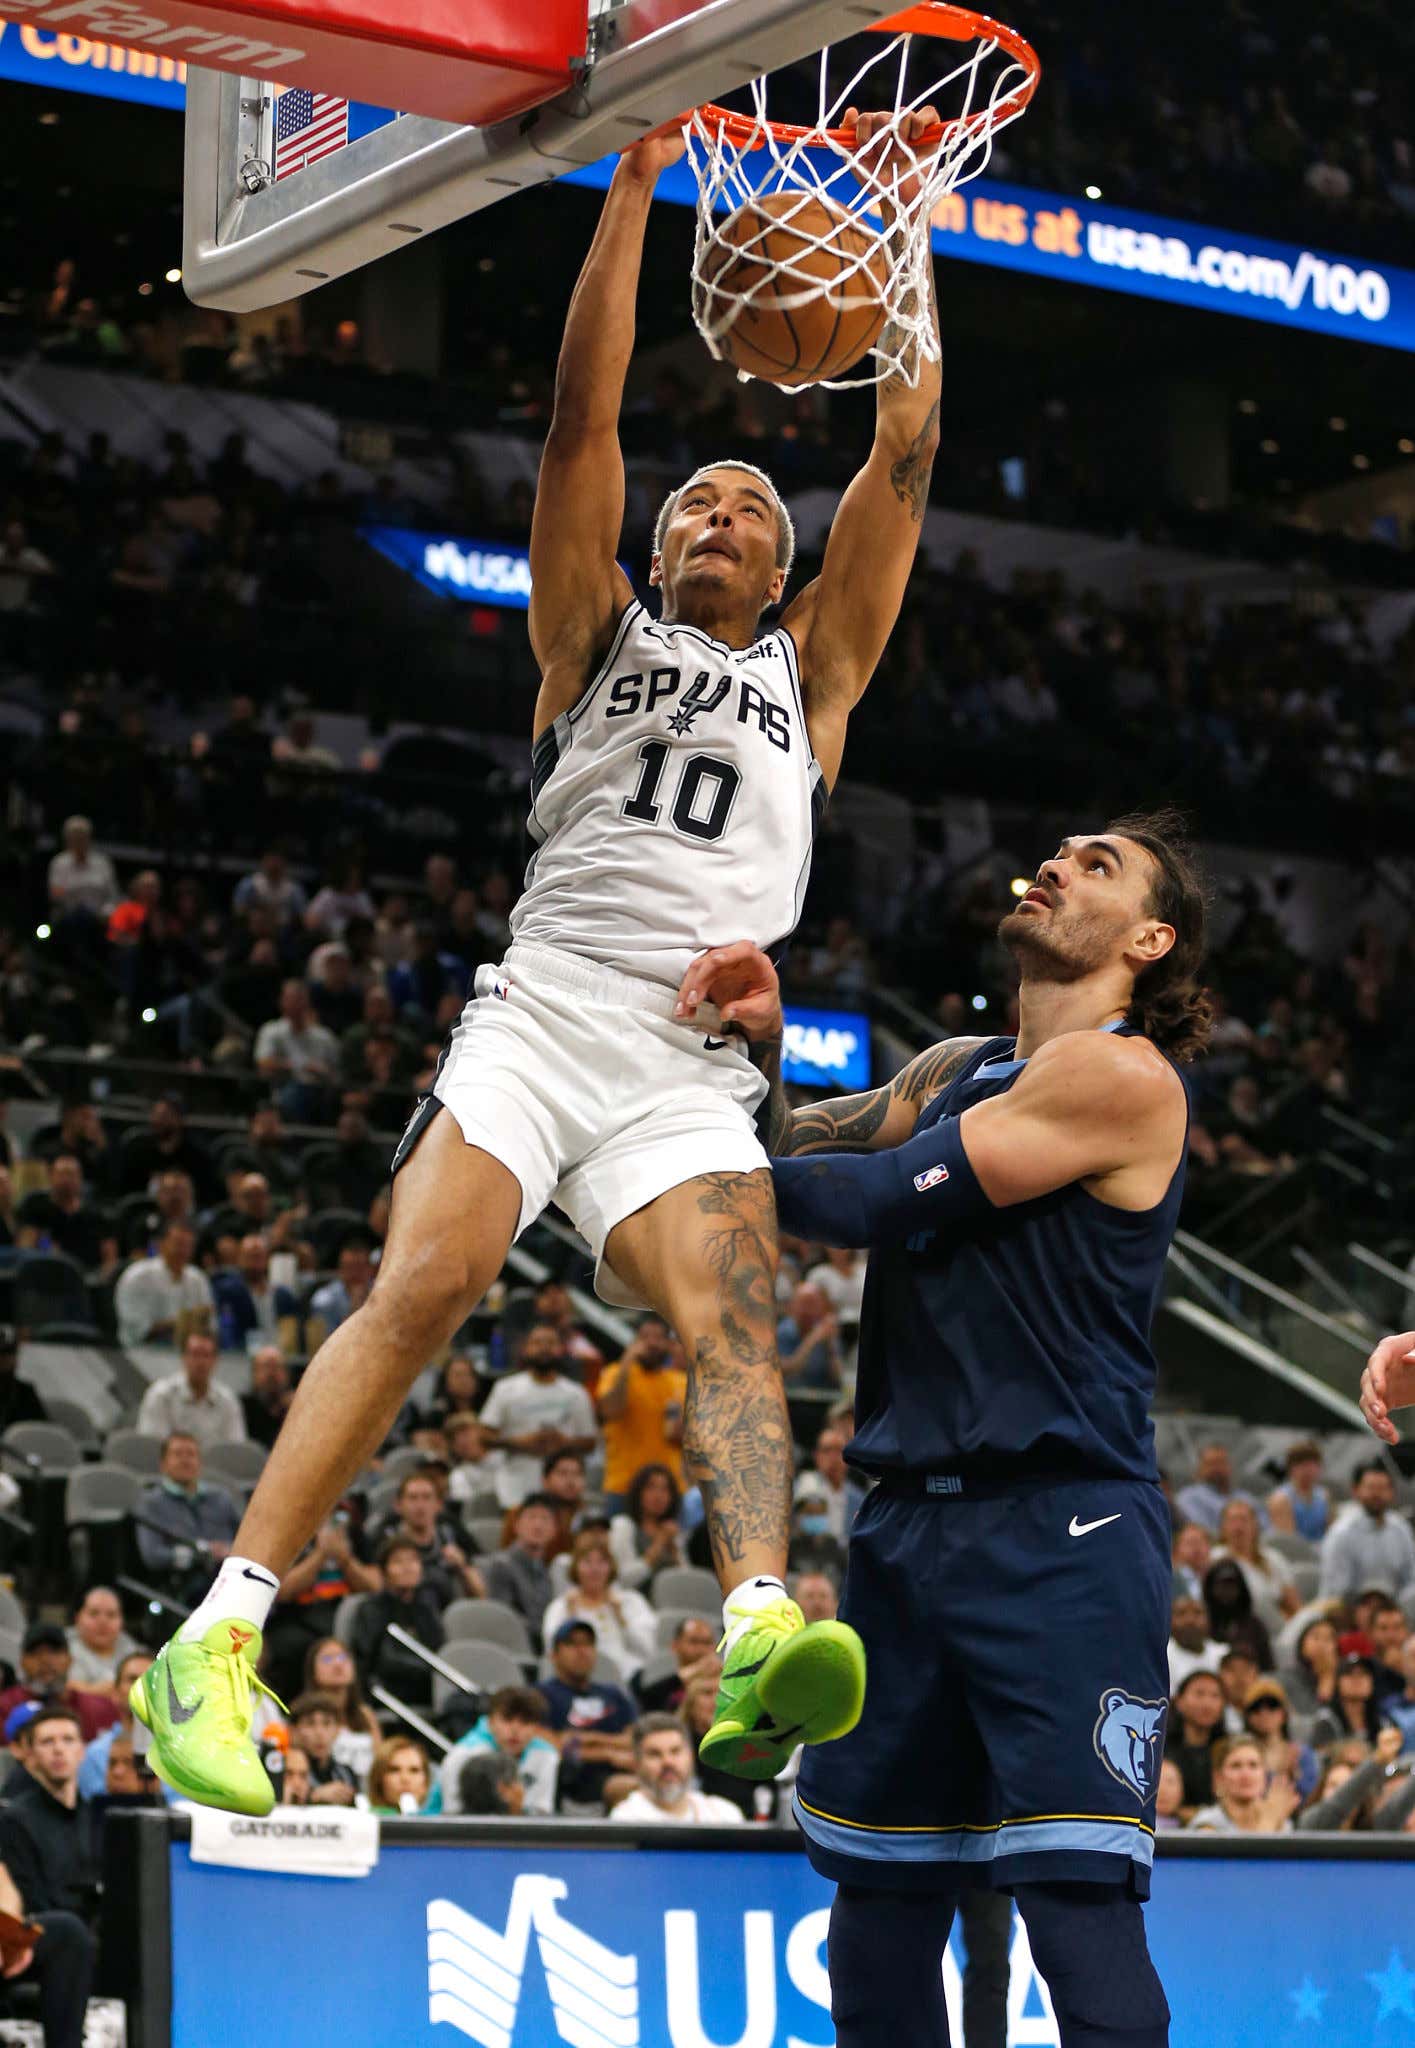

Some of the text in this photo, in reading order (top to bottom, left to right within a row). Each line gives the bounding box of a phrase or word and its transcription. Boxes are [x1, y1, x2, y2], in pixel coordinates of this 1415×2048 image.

[972, 197, 1028, 246] us
[1032, 206, 1083, 258] at
[1087, 221, 1391, 321] usaa.com/100
[605, 667, 791, 753] SPURS
[619, 737, 744, 845] 10
[229, 1819, 344, 1840] GATORADE
